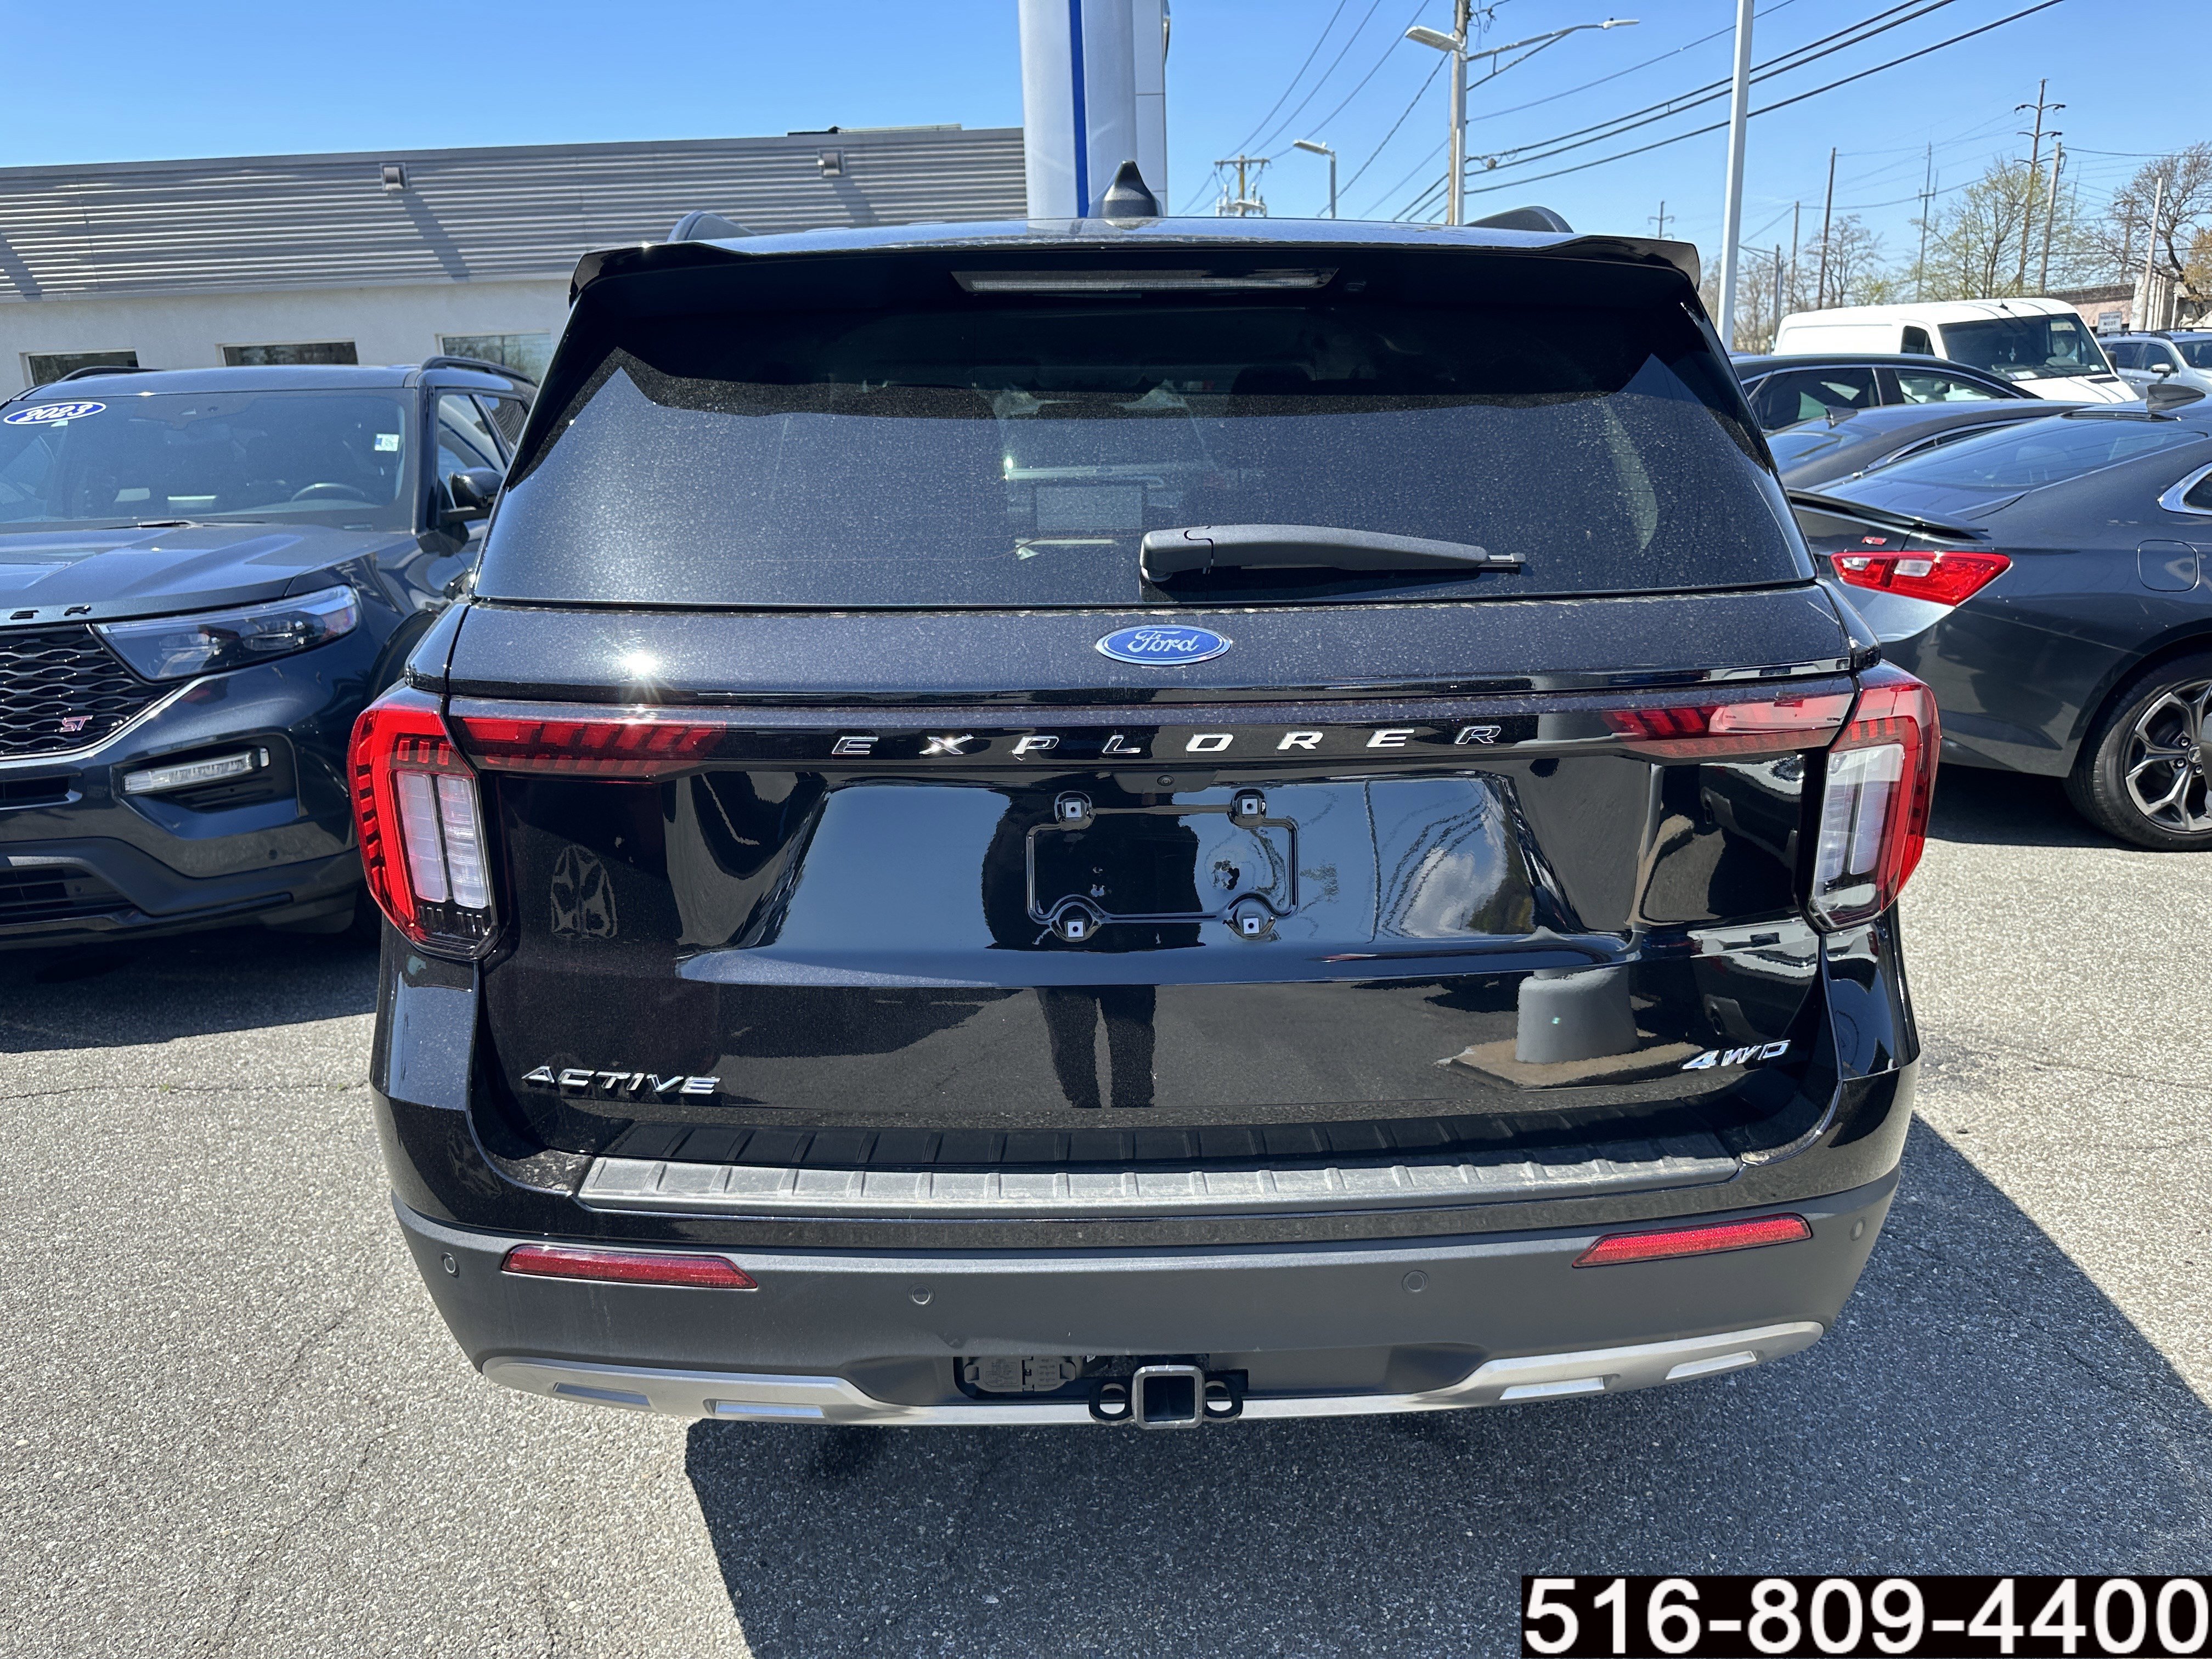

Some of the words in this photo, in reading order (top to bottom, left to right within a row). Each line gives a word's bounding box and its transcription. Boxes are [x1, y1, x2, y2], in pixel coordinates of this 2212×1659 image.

[16, 403, 94, 422] 2023
[1127, 630, 1200, 652] Ford
[59, 715, 93, 732] ST
[831, 725, 1501, 755] EXPLORER
[1682, 1039, 1791, 1070] 4WD
[521, 1065, 722, 1095] ACTIVE
